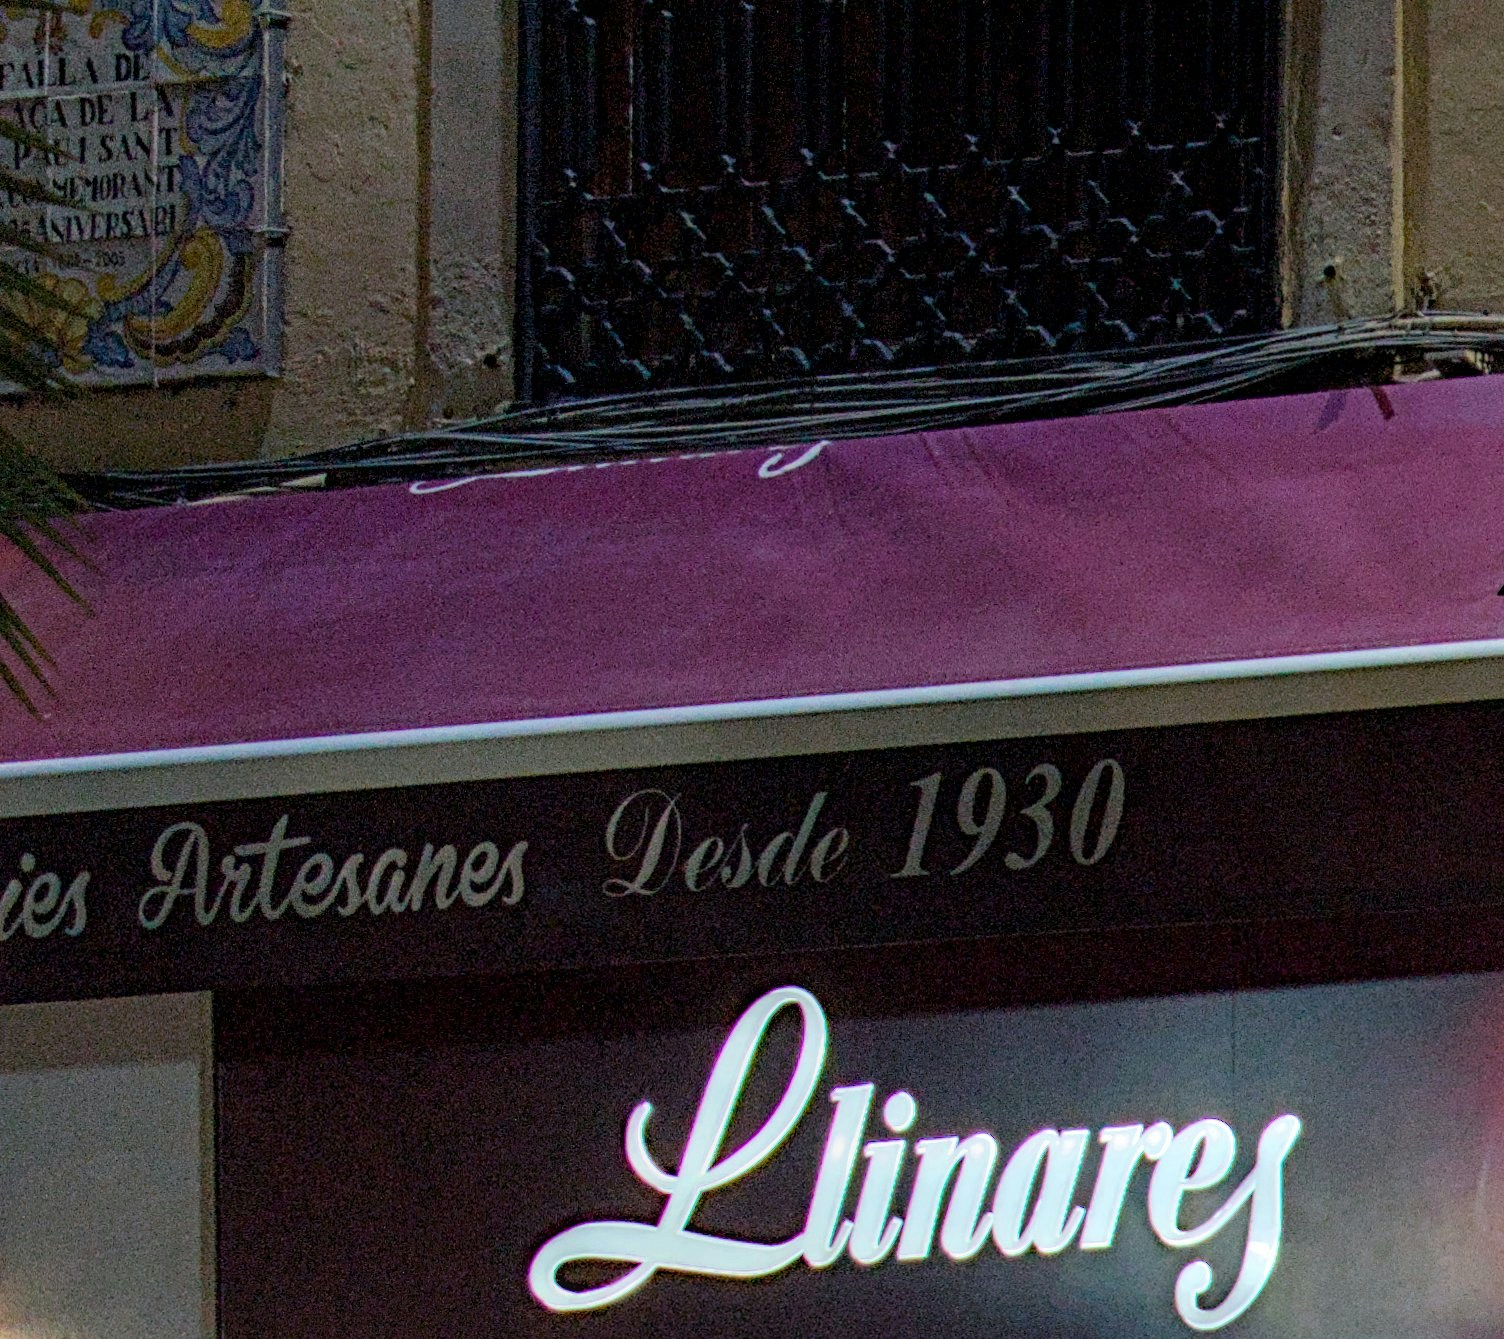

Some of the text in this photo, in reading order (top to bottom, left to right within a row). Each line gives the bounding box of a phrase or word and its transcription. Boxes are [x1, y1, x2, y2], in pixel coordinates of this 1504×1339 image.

[115, 52, 150, 83] DE
[80, 94, 114, 127] DE
[129, 88, 174, 123] LA
[99, 127, 178, 163] SANT
[139, 814, 531, 930] Artesanes
[602, 787, 852, 900] Desde
[890, 757, 1126, 880] 1930
[527, 985, 1302, 1331] Llinares
